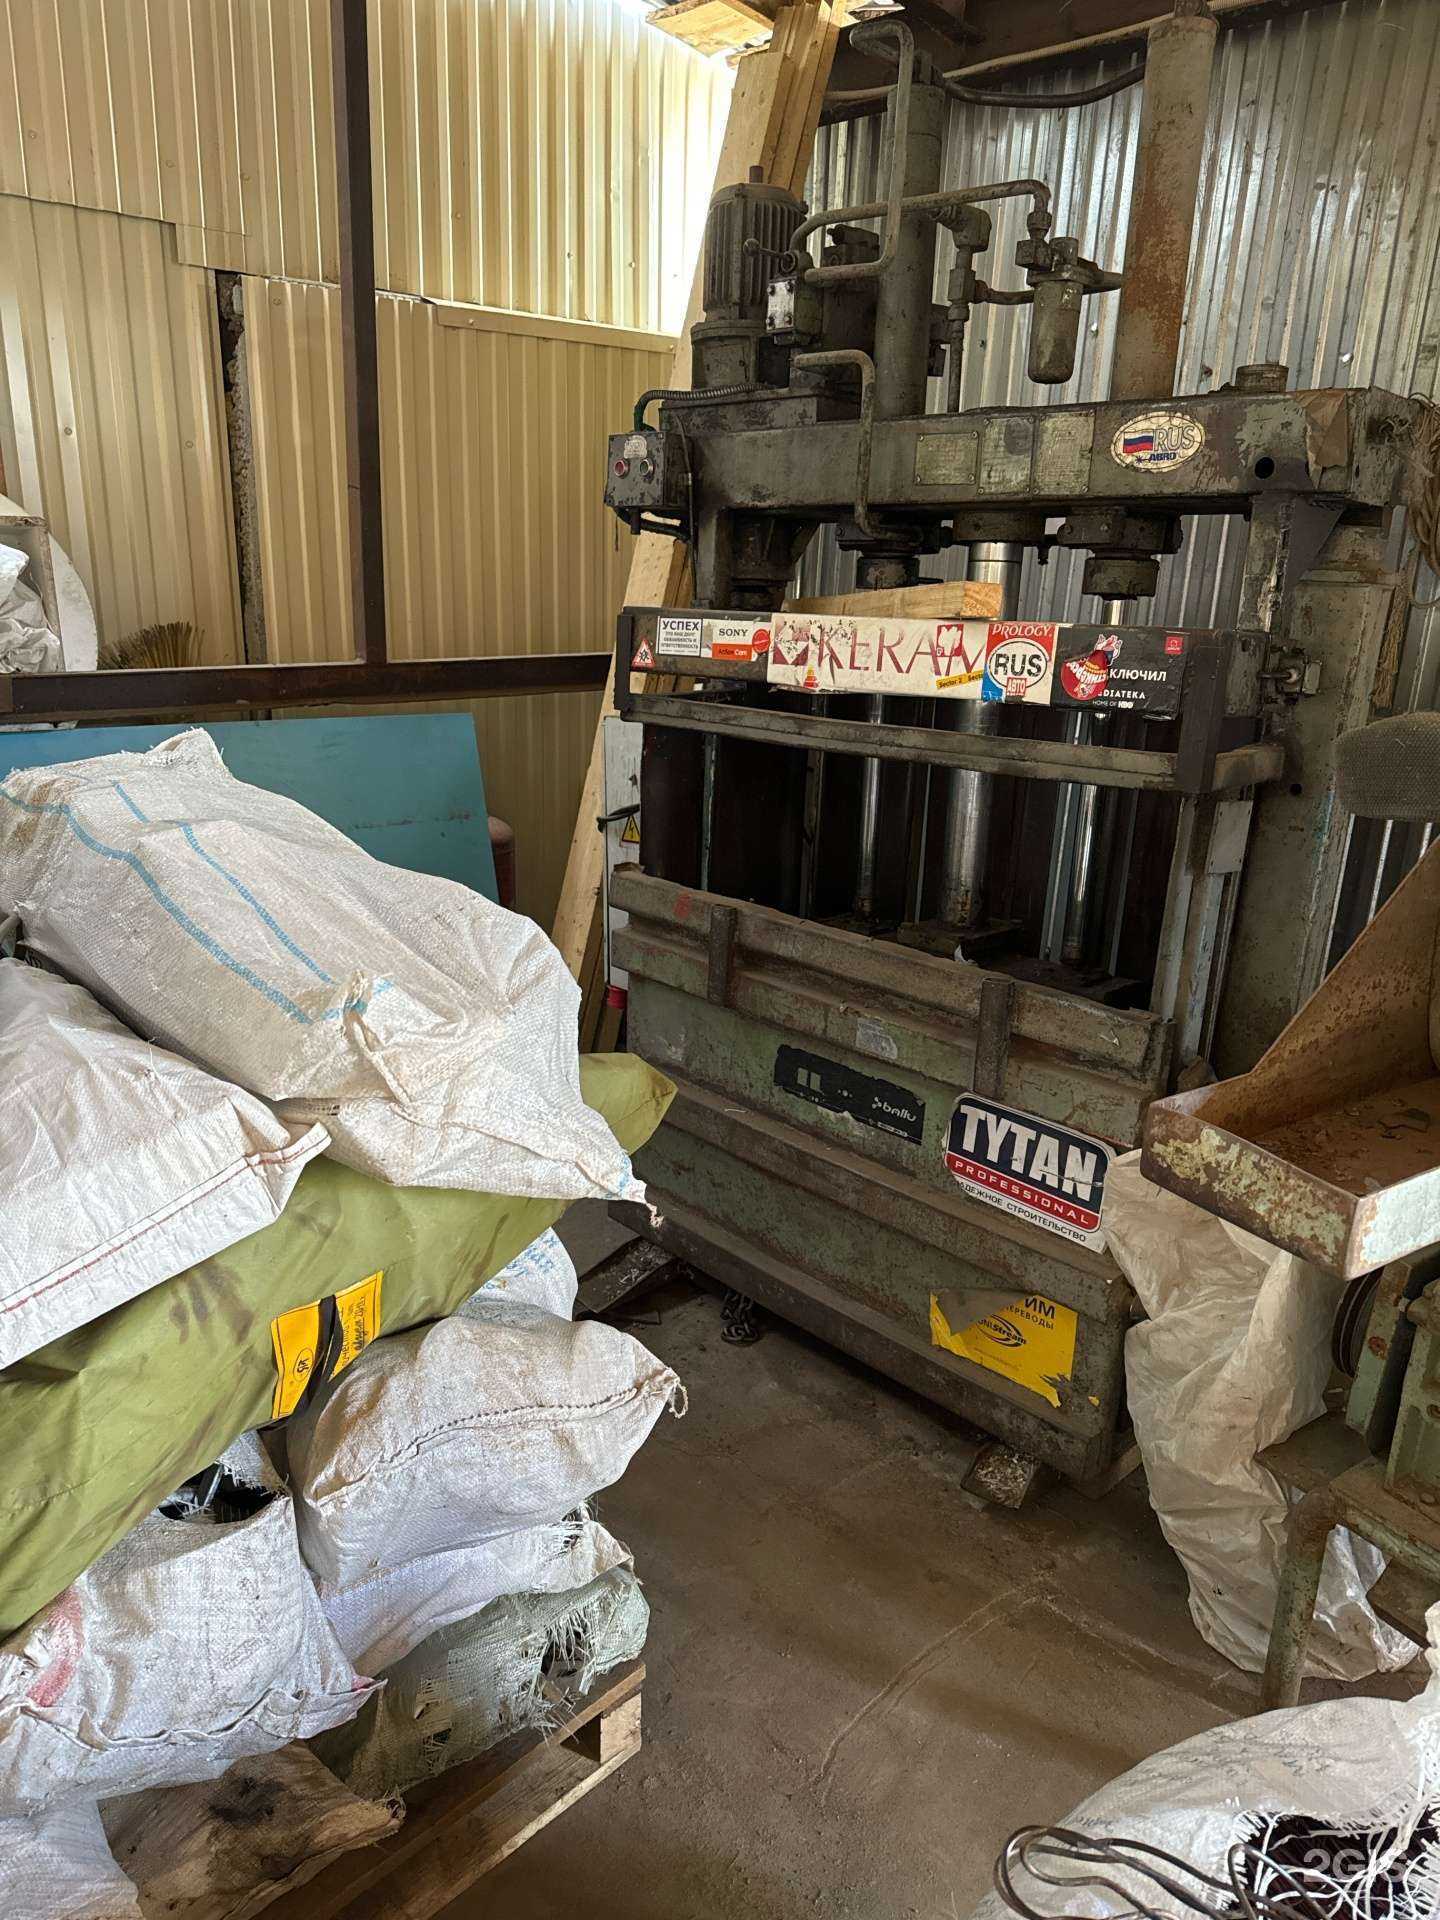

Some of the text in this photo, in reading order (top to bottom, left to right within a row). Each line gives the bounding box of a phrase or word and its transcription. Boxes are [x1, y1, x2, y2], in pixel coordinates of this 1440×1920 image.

[1154, 425, 1195, 451] RUS
[1149, 452, 1177, 461] ABRO
[662, 620, 699, 631] УСПЕХ
[719, 628, 748, 637] SONY
[994, 653, 1043, 677] RUS
[1109, 669, 1167, 681] КЛЮЧИЛ
[1007, 679, 1026, 693] АВТО
[960, 1104, 1097, 1202] TYTAN
[955, 1160, 1089, 1225] PROFESSIONAL
[1006, 1203, 1086, 1243] СТРОИТЕЛЬСТВО
